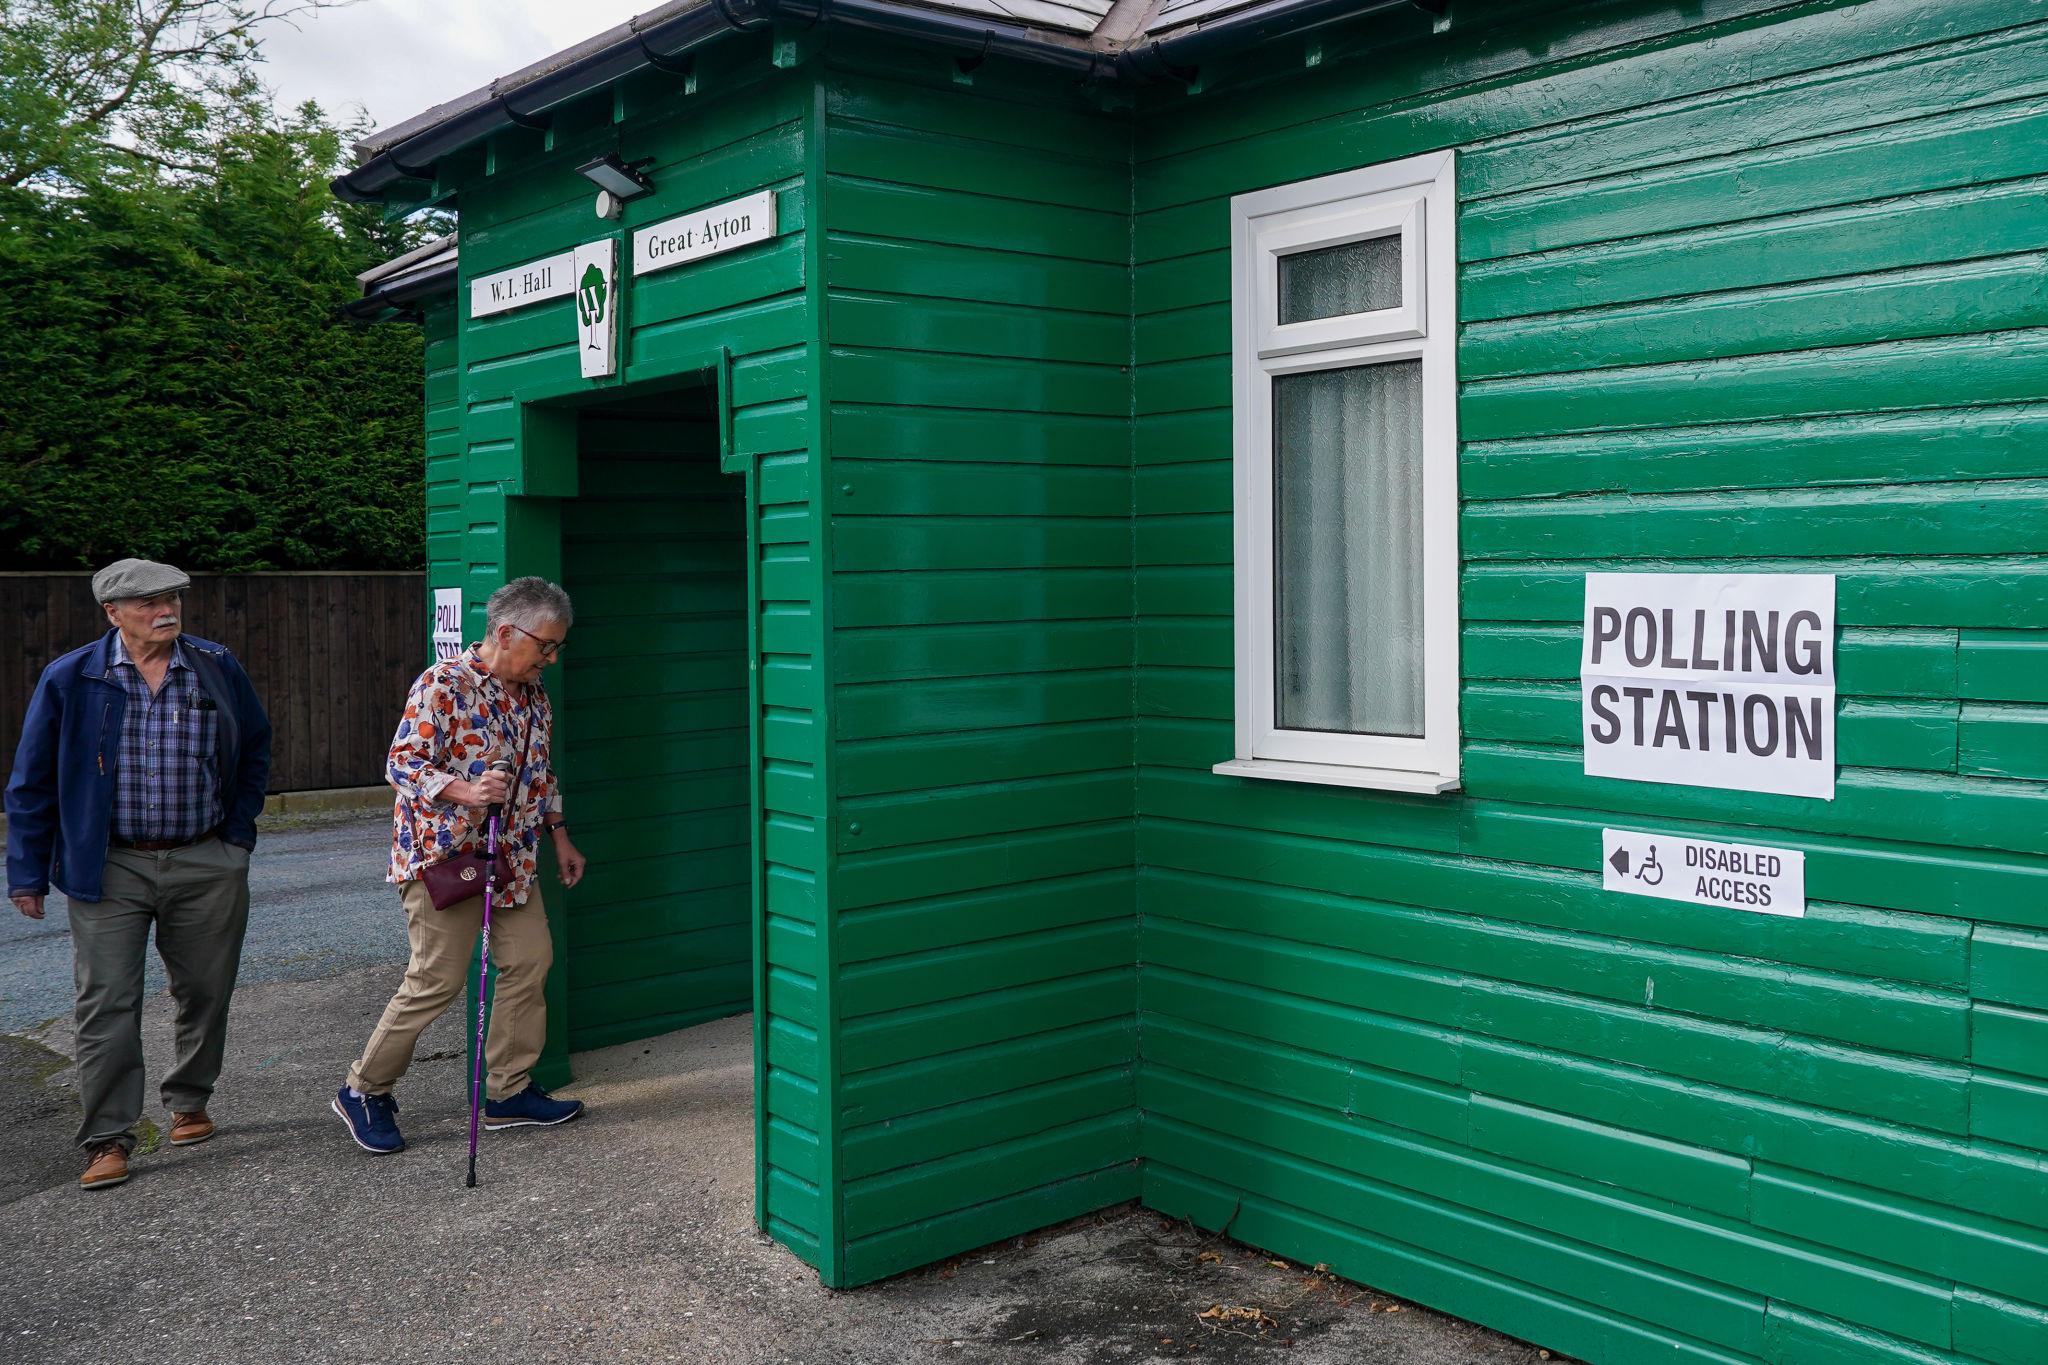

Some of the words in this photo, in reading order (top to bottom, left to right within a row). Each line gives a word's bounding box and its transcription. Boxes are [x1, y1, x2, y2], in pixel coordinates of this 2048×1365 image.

[648, 228, 692, 259] Great
[701, 214, 751, 249] Ayton
[491, 278, 517, 302] W.I.
[523, 266, 551, 294] Hall
[436, 604, 462, 633] POLL
[1591, 606, 1823, 675] POLLING
[1590, 685, 1823, 761] STATION
[1685, 845, 1781, 878] DISABLED
[1695, 875, 1772, 906] ACCESS
